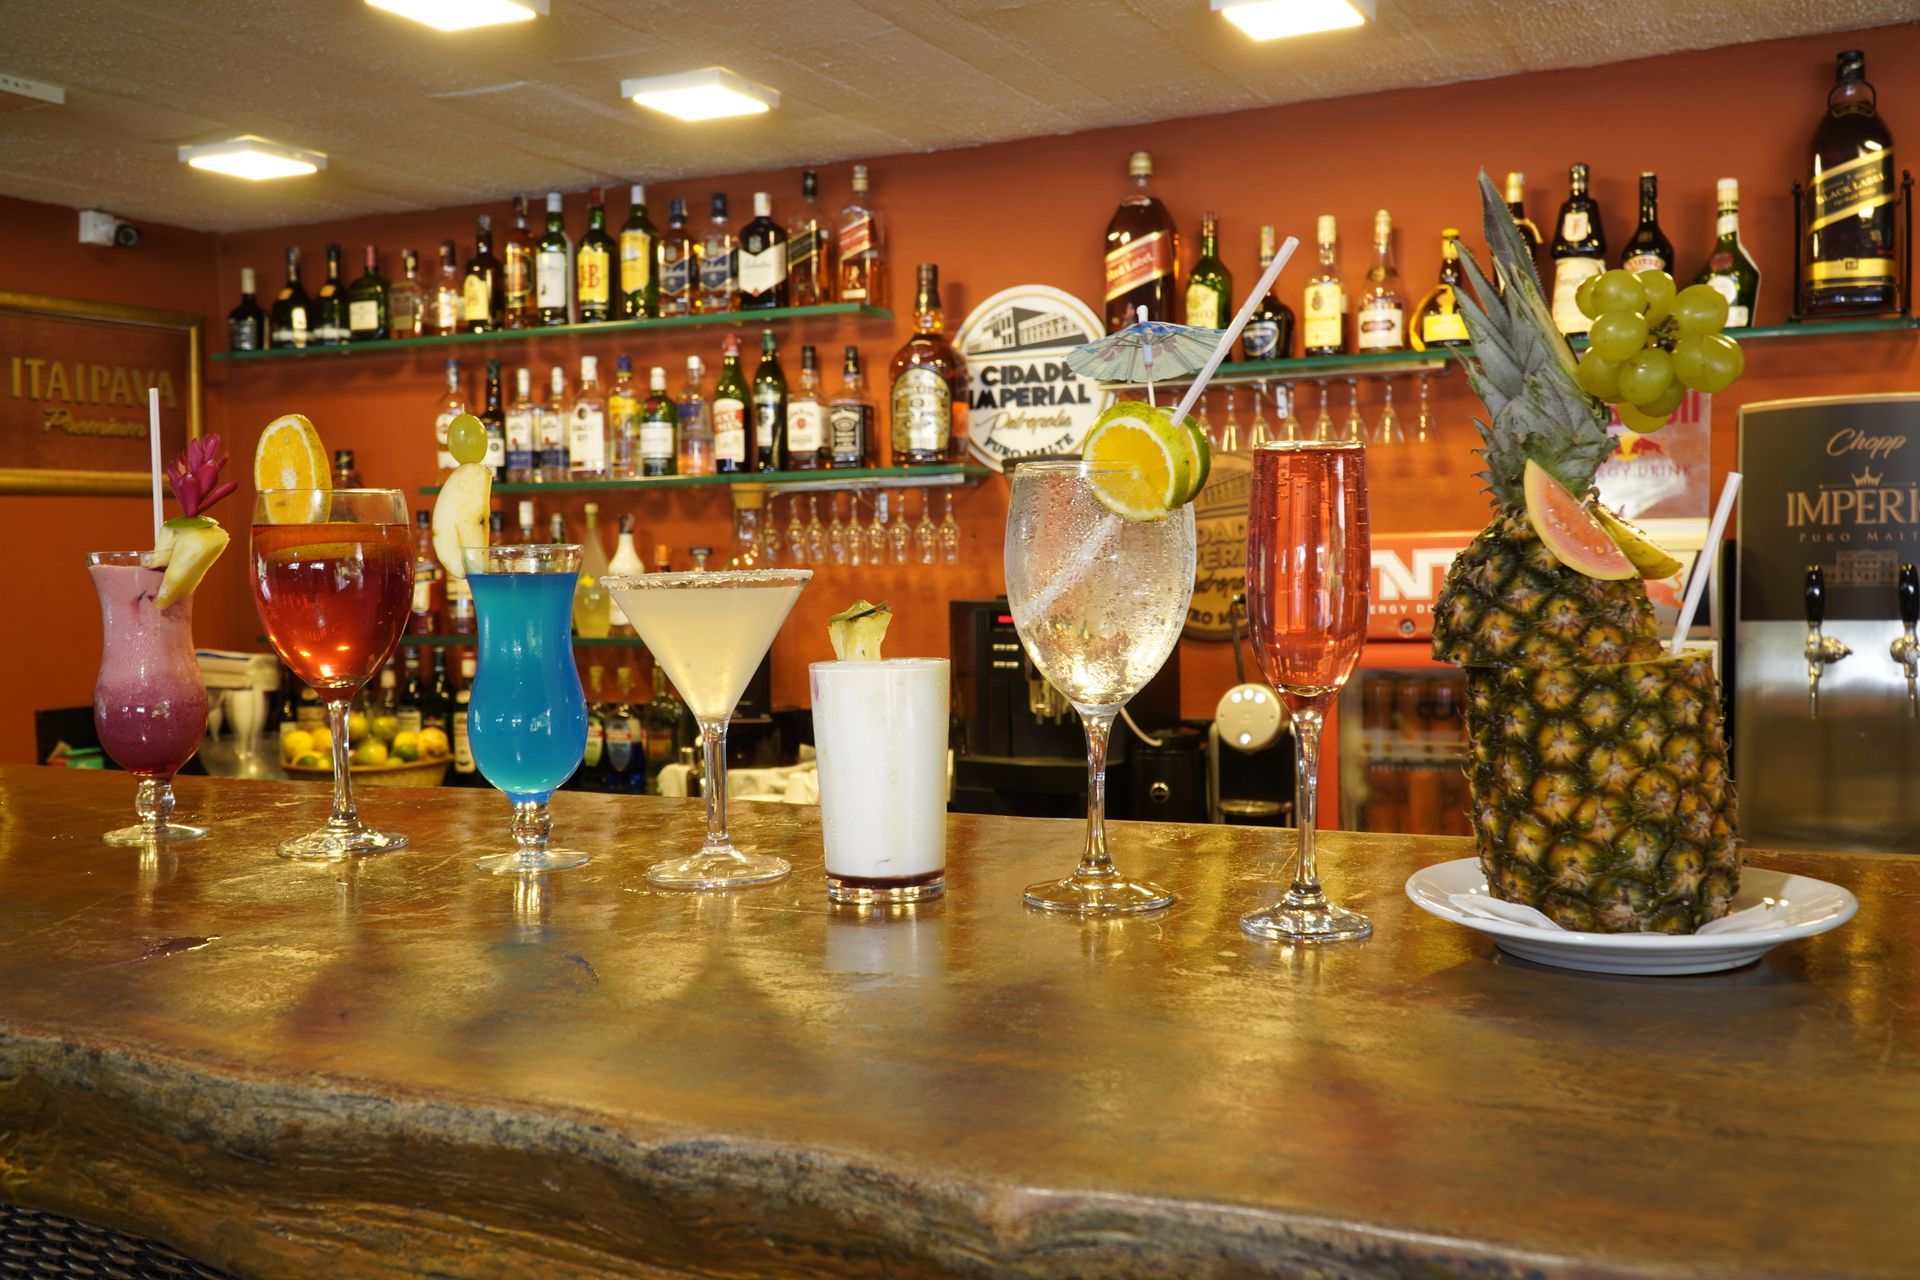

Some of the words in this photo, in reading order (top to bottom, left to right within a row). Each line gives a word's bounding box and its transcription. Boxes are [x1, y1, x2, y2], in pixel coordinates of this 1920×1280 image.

[1852, 171, 1884, 191] LABEL
[11, 356, 176, 409] ITAIPAVA
[980, 361, 1077, 387] CIDADE
[968, 384, 1091, 411] IMPERIAL
[43, 408, 147, 437] Premium
[983, 436, 1021, 459] PURO
[1026, 432, 1075, 458] MALTE
[1826, 428, 1906, 458] Chopp
[1637, 463, 1693, 479] DRINK
[1786, 482, 1920, 528] IMPERI
[1800, 532, 1850, 544] PURO
[1866, 531, 1920, 543] MALT
[1370, 603, 1408, 615] ERGY
